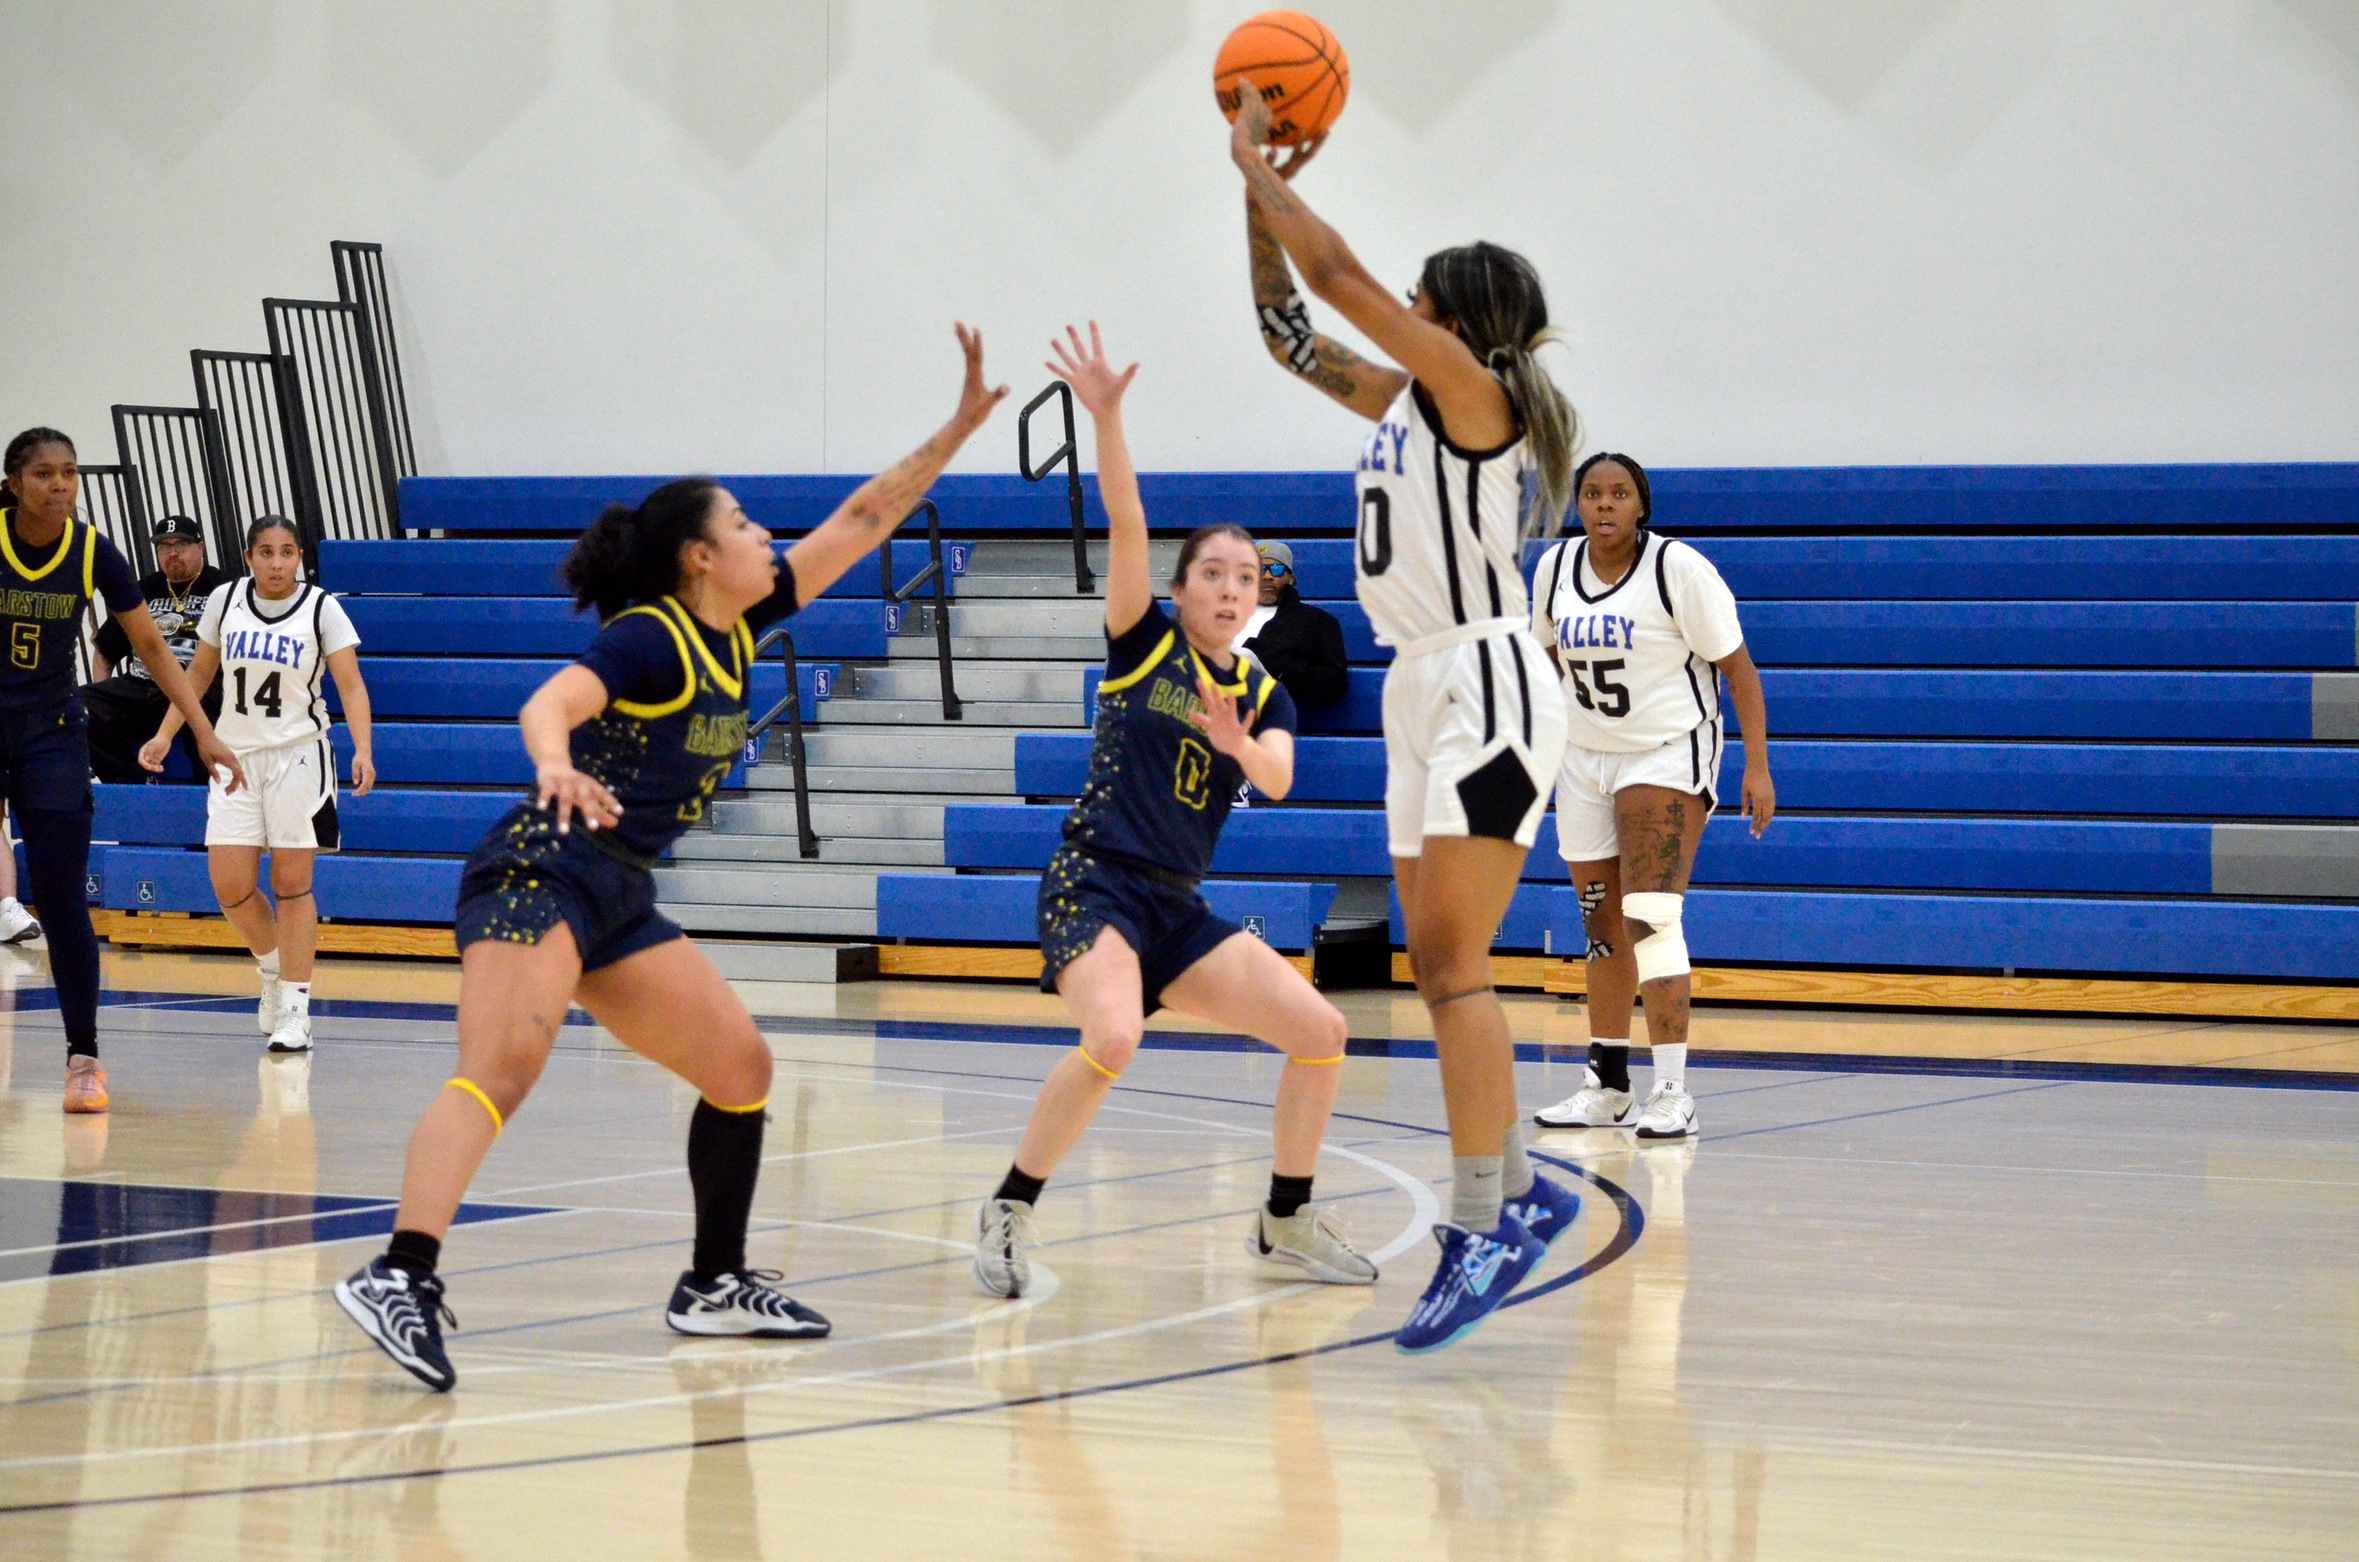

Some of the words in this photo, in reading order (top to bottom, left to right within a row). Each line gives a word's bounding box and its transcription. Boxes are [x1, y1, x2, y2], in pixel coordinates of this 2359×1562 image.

[166, 519, 176, 533] B
[11, 622, 41, 669] 5
[226, 630, 305, 669] VALLEY
[233, 666, 283, 718] 14
